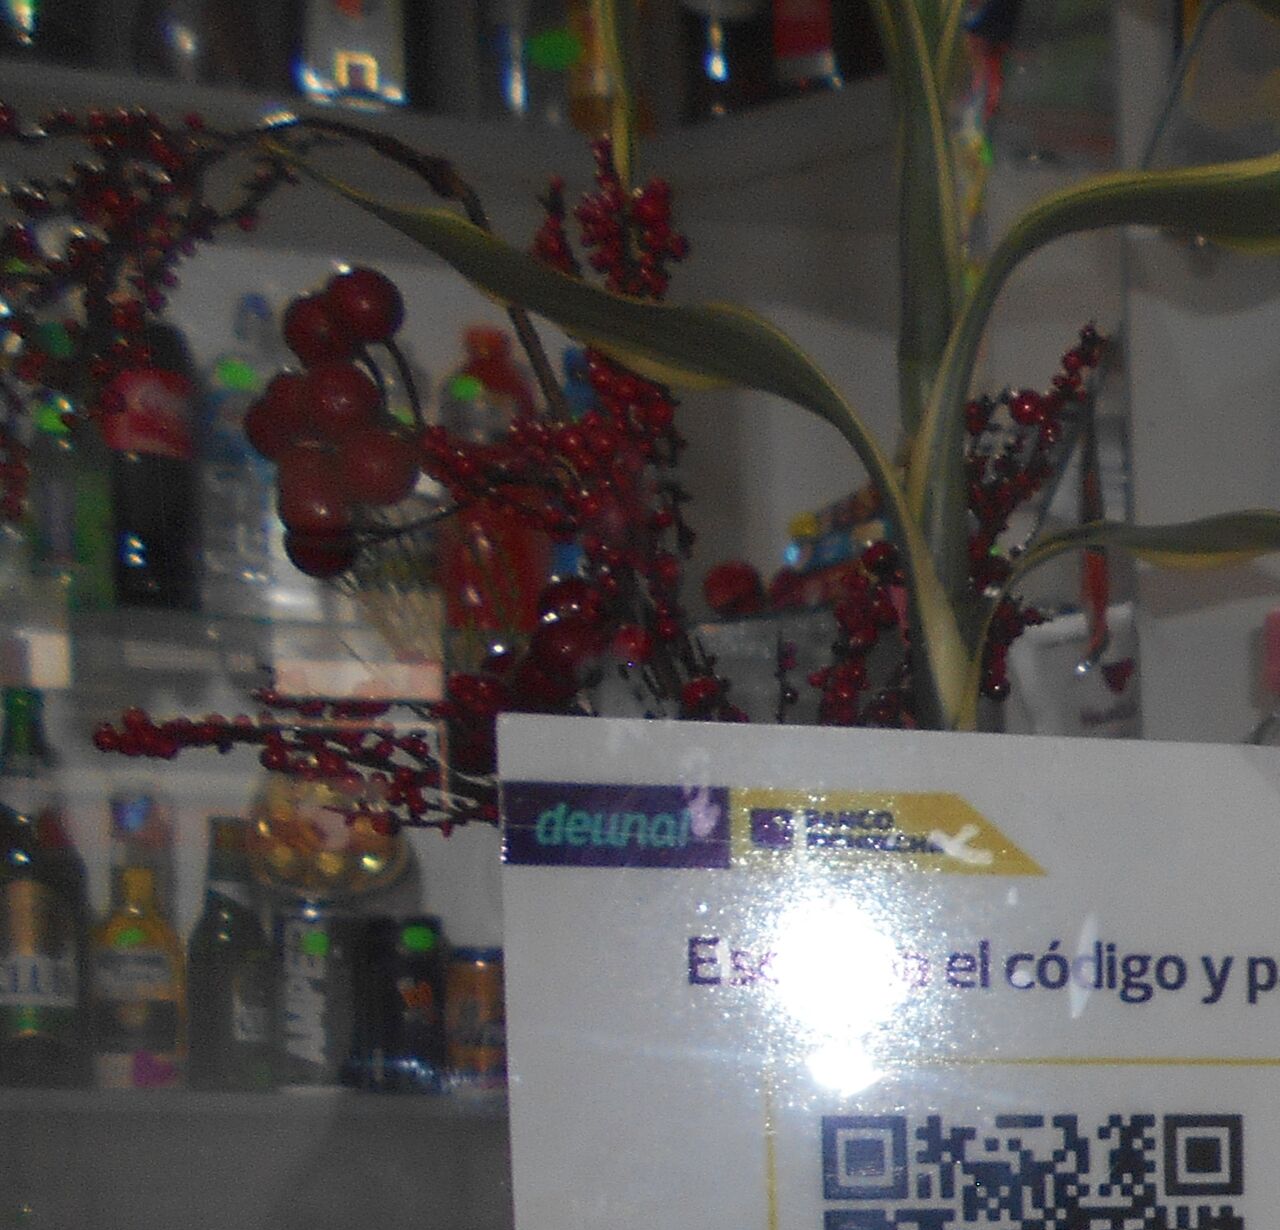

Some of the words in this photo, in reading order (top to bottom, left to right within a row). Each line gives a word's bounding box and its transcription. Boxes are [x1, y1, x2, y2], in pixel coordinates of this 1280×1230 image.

[948, 940, 990, 988] el
[1005, 940, 1188, 1004] código
[1200, 954, 1235, 1004] y
